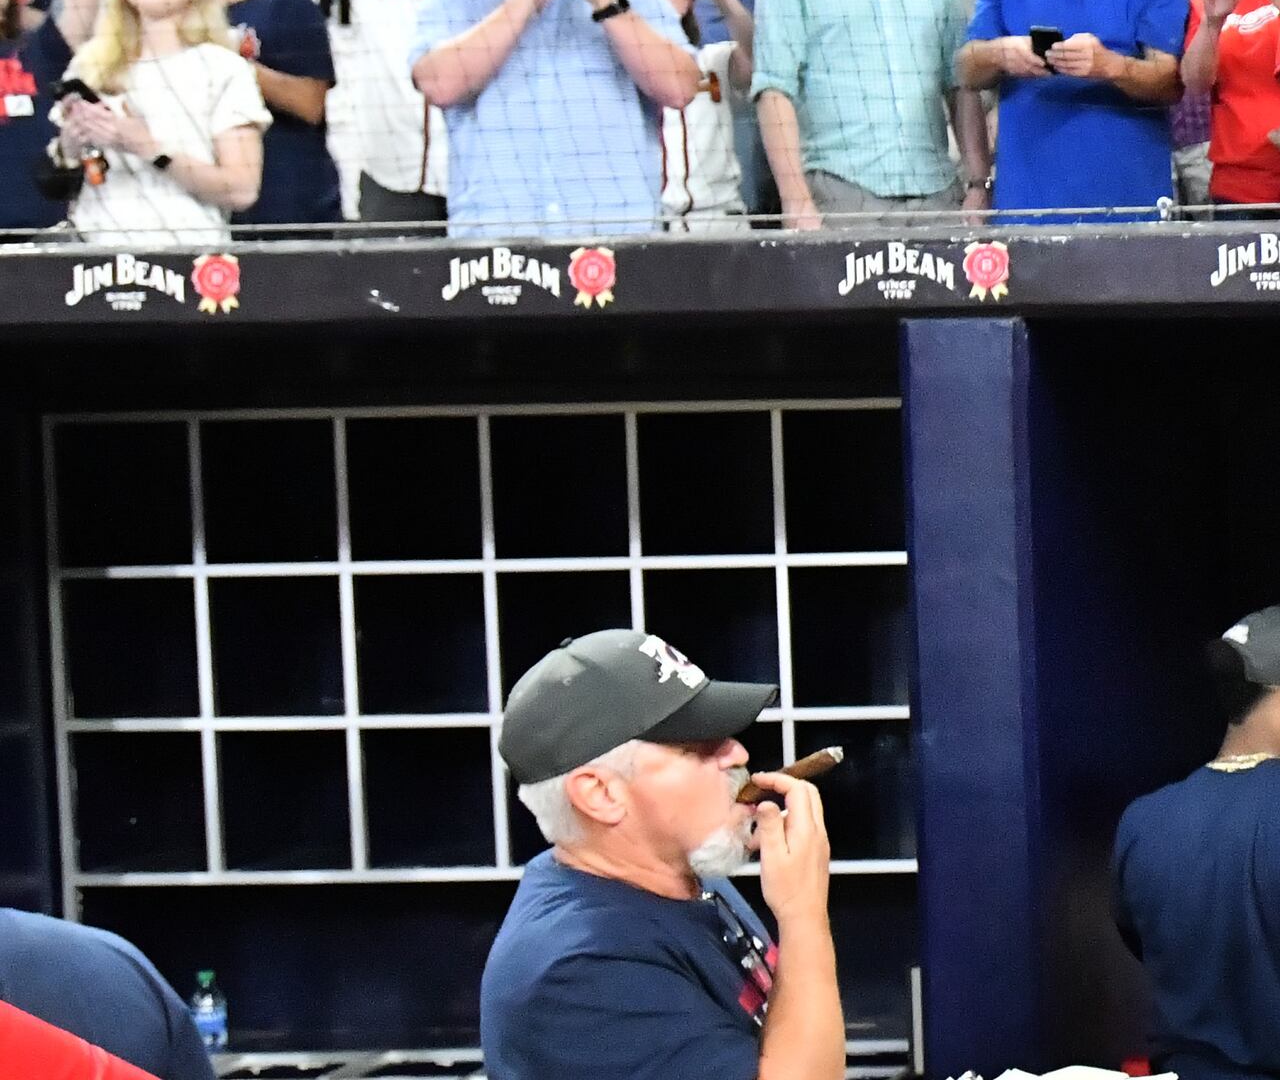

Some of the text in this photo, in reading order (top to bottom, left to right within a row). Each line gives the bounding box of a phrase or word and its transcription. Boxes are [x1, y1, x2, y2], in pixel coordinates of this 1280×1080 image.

[65, 253, 185, 306] JIM BEAM
[442, 247, 561, 301] JIM BEAM
[837, 239, 956, 296] JIM BEAM
[1211, 242, 1257, 287] JIM
